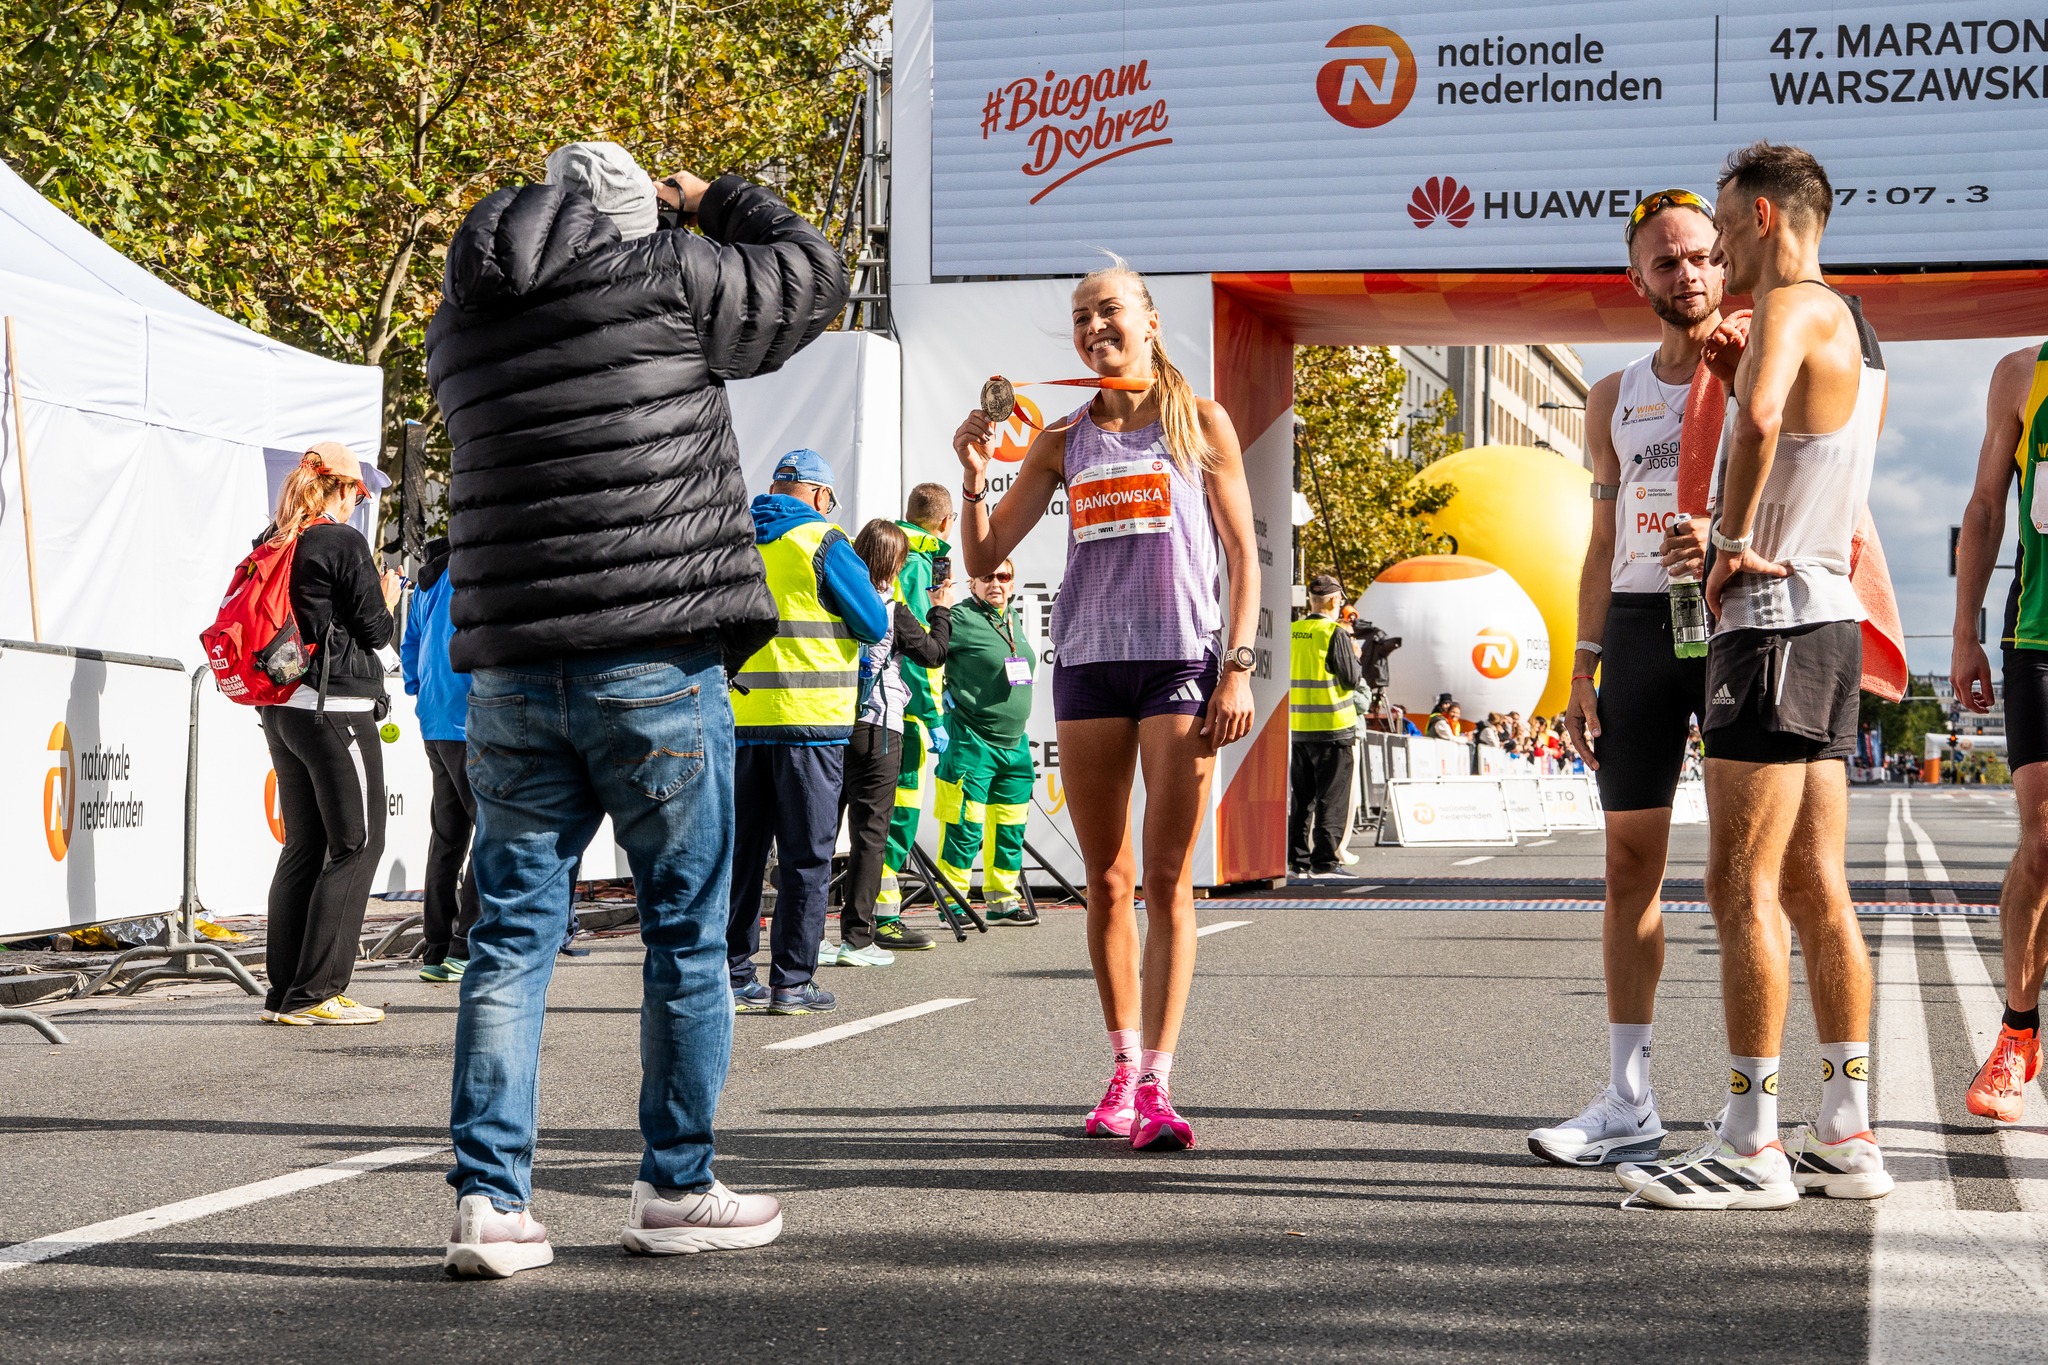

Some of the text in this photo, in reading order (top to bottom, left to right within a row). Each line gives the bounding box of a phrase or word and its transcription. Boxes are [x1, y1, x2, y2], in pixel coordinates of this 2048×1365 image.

[1437, 33, 1605, 67] nationale
[1769, 18, 2048, 60] 47. MARATON
[980, 59, 1152, 140] #Biegam
[1437, 70, 1662, 105] nederlanden
[1834, 185, 1989, 206] 7:07.3
[1637, 403, 1666, 414] WINGS
[1646, 456, 1679, 471] JOGGI
[1075, 487, 1163, 513] BAŃKOWSKA
[1636, 512, 1676, 534] PAC
[1711, 697, 1736, 705] adidas
[80, 743, 130, 781] nationale
[80, 791, 144, 830] nederlanden
[466, 1204, 474, 1236] 1080
